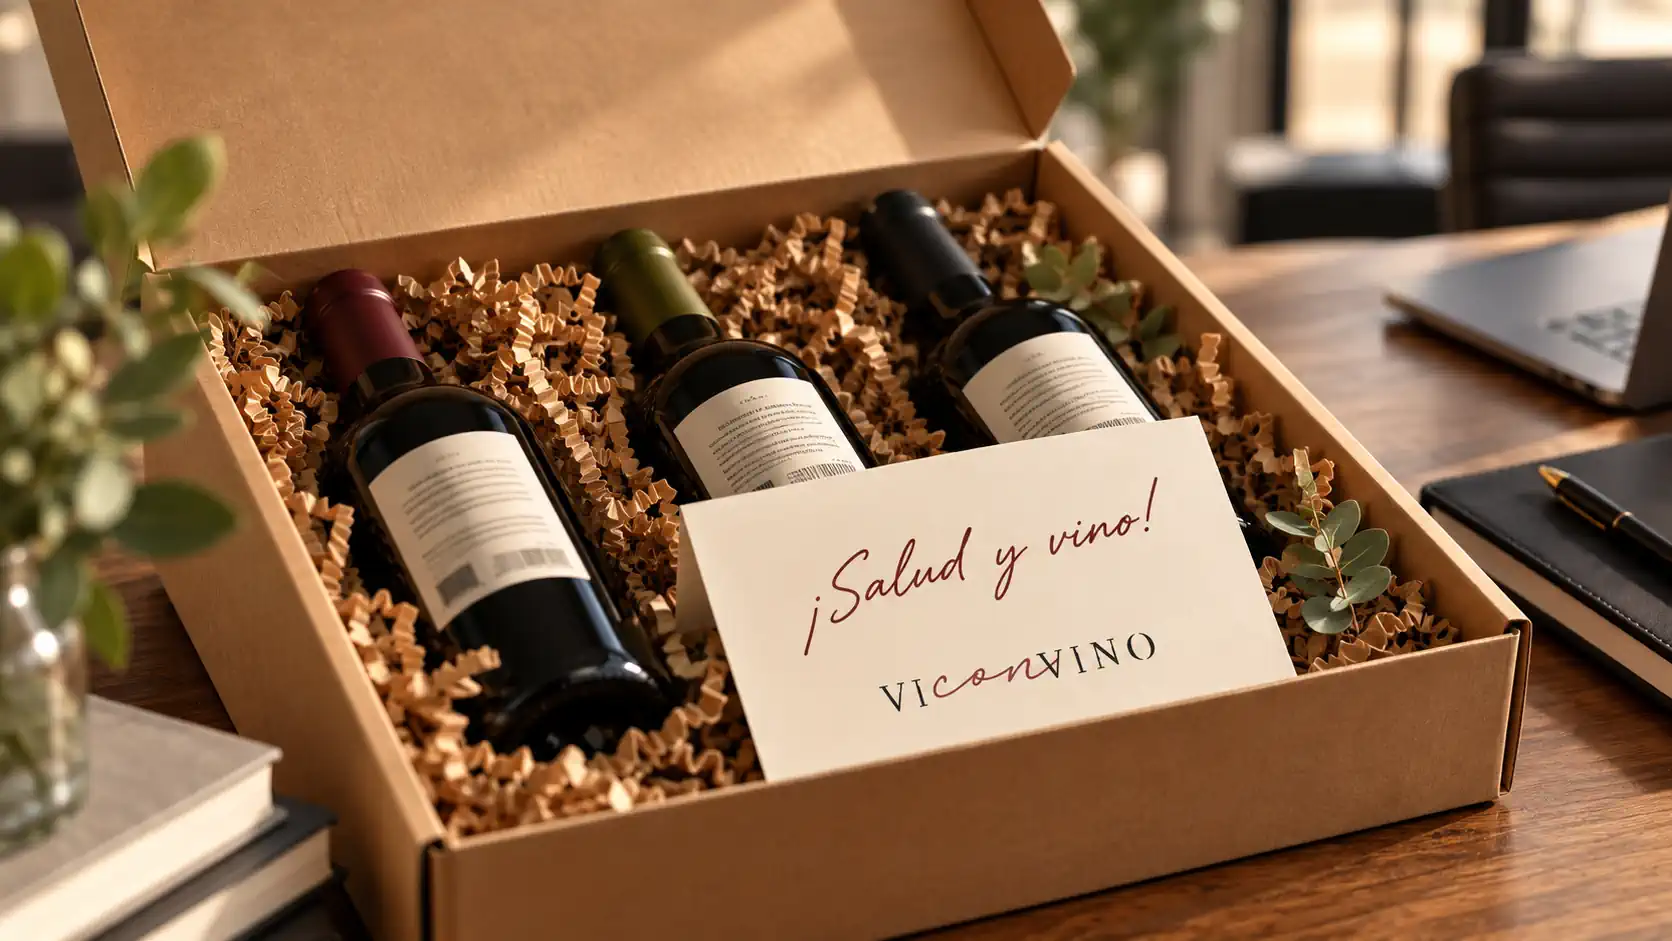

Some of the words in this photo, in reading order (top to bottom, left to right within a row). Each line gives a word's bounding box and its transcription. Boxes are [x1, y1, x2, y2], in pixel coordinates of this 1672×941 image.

[804, 527, 973, 657] ¡Salud
[994, 545, 1029, 601] y
[1049, 477, 1158, 556] vino!
